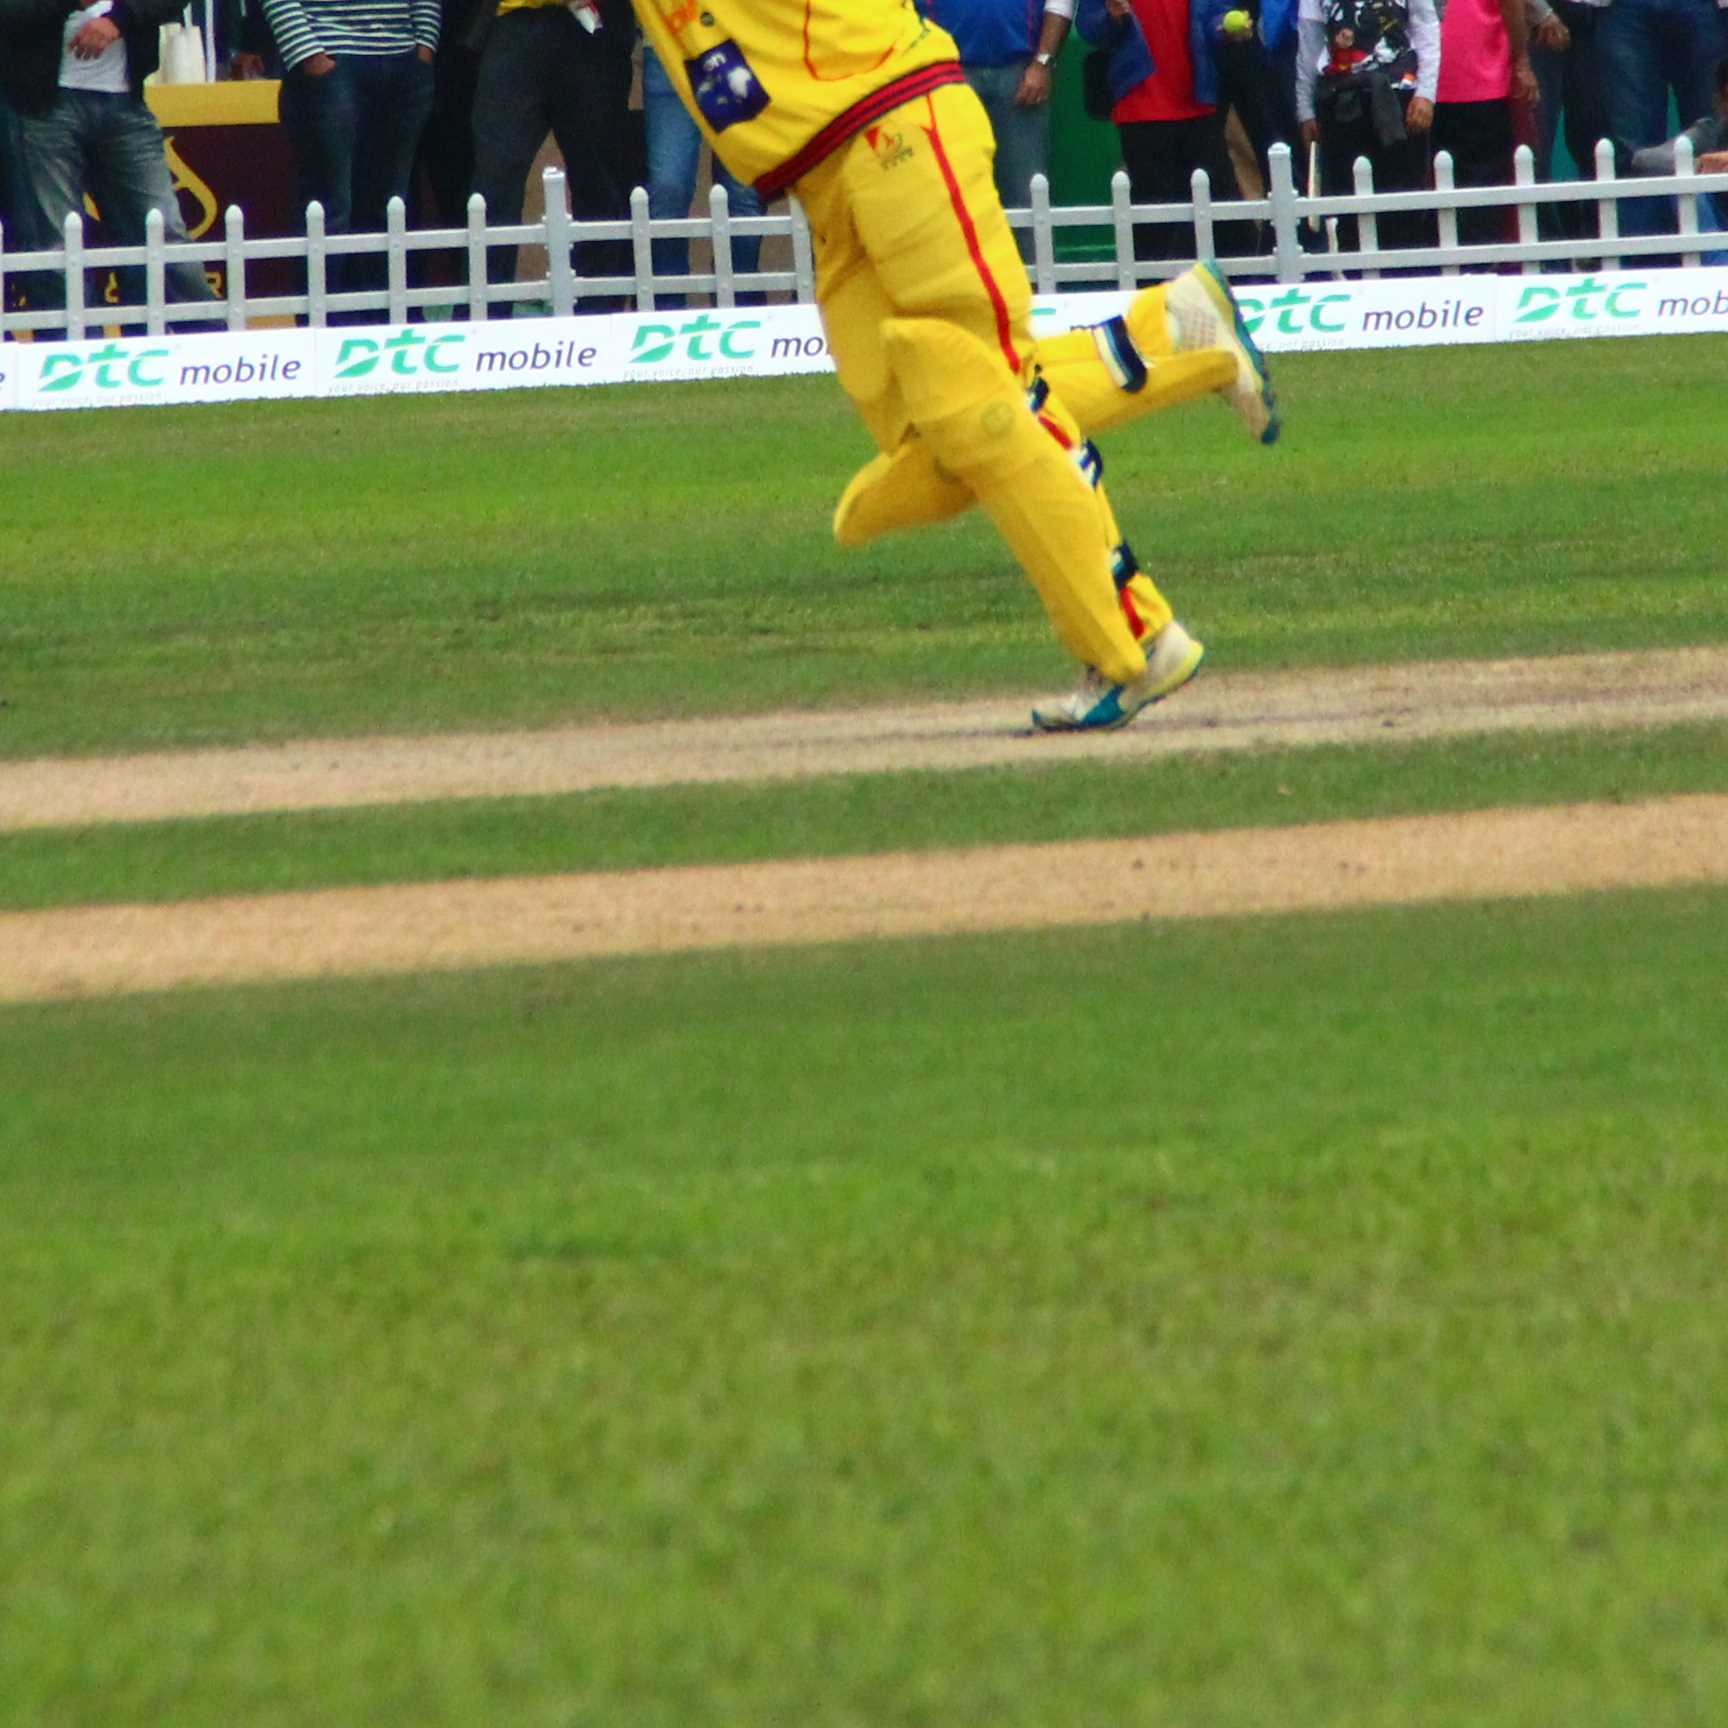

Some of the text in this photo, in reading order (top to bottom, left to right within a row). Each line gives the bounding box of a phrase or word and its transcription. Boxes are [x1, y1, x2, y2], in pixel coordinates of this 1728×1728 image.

[1362, 300, 1484, 332] mobile
[476, 340, 597, 372] mobile
[771, 335, 830, 358] mo
[179, 353, 302, 386] mobile
